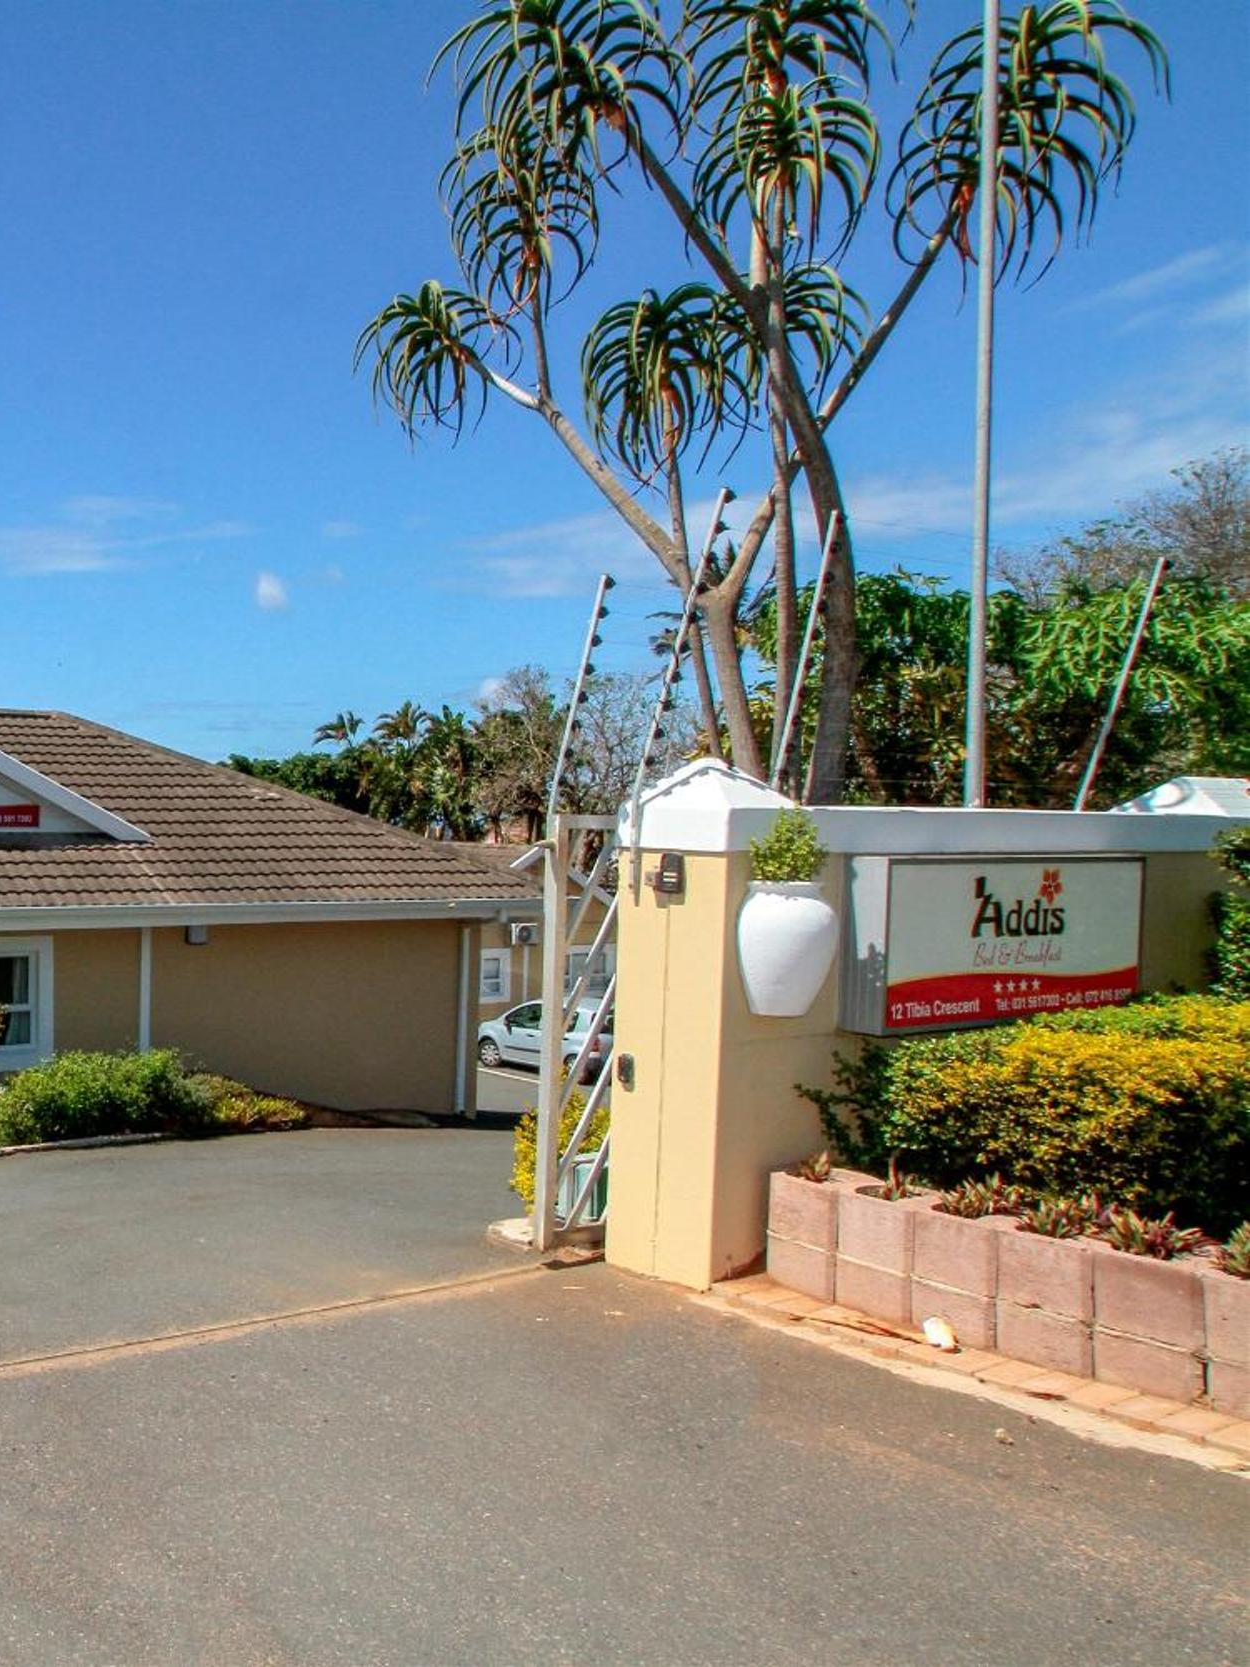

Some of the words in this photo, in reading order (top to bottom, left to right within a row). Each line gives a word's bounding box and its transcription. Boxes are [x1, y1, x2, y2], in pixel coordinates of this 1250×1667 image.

[970, 877, 1065, 938] Addis
[973, 942, 997, 967] Bed
[998, 943, 1012, 966] &
[1014, 939, 1063, 967] Breakfast
[891, 1002, 903, 1020] 12
[905, 1001, 931, 1019] Tibia
[933, 997, 980, 1016] Crescent
[995, 998, 1010, 1011] Tel:
